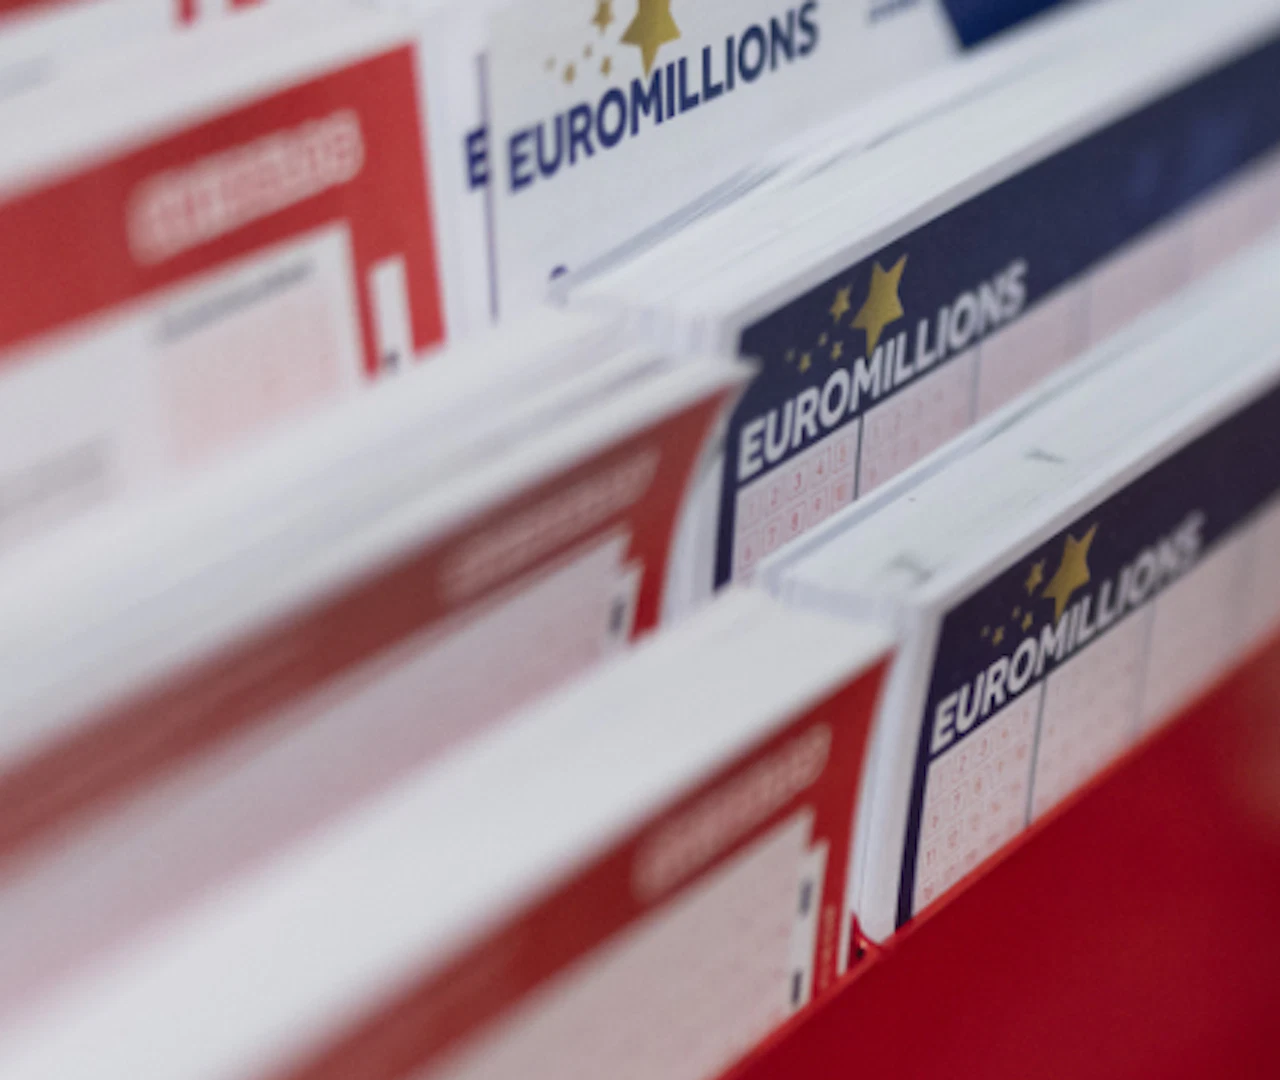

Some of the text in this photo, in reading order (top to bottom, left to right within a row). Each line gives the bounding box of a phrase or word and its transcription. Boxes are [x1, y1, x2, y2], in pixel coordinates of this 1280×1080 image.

[508, 2, 819, 194] EUROMILLIONS
[737, 260, 1028, 482] EUROMILLIONS
[929, 512, 1206, 755] EUROMILLIONS
